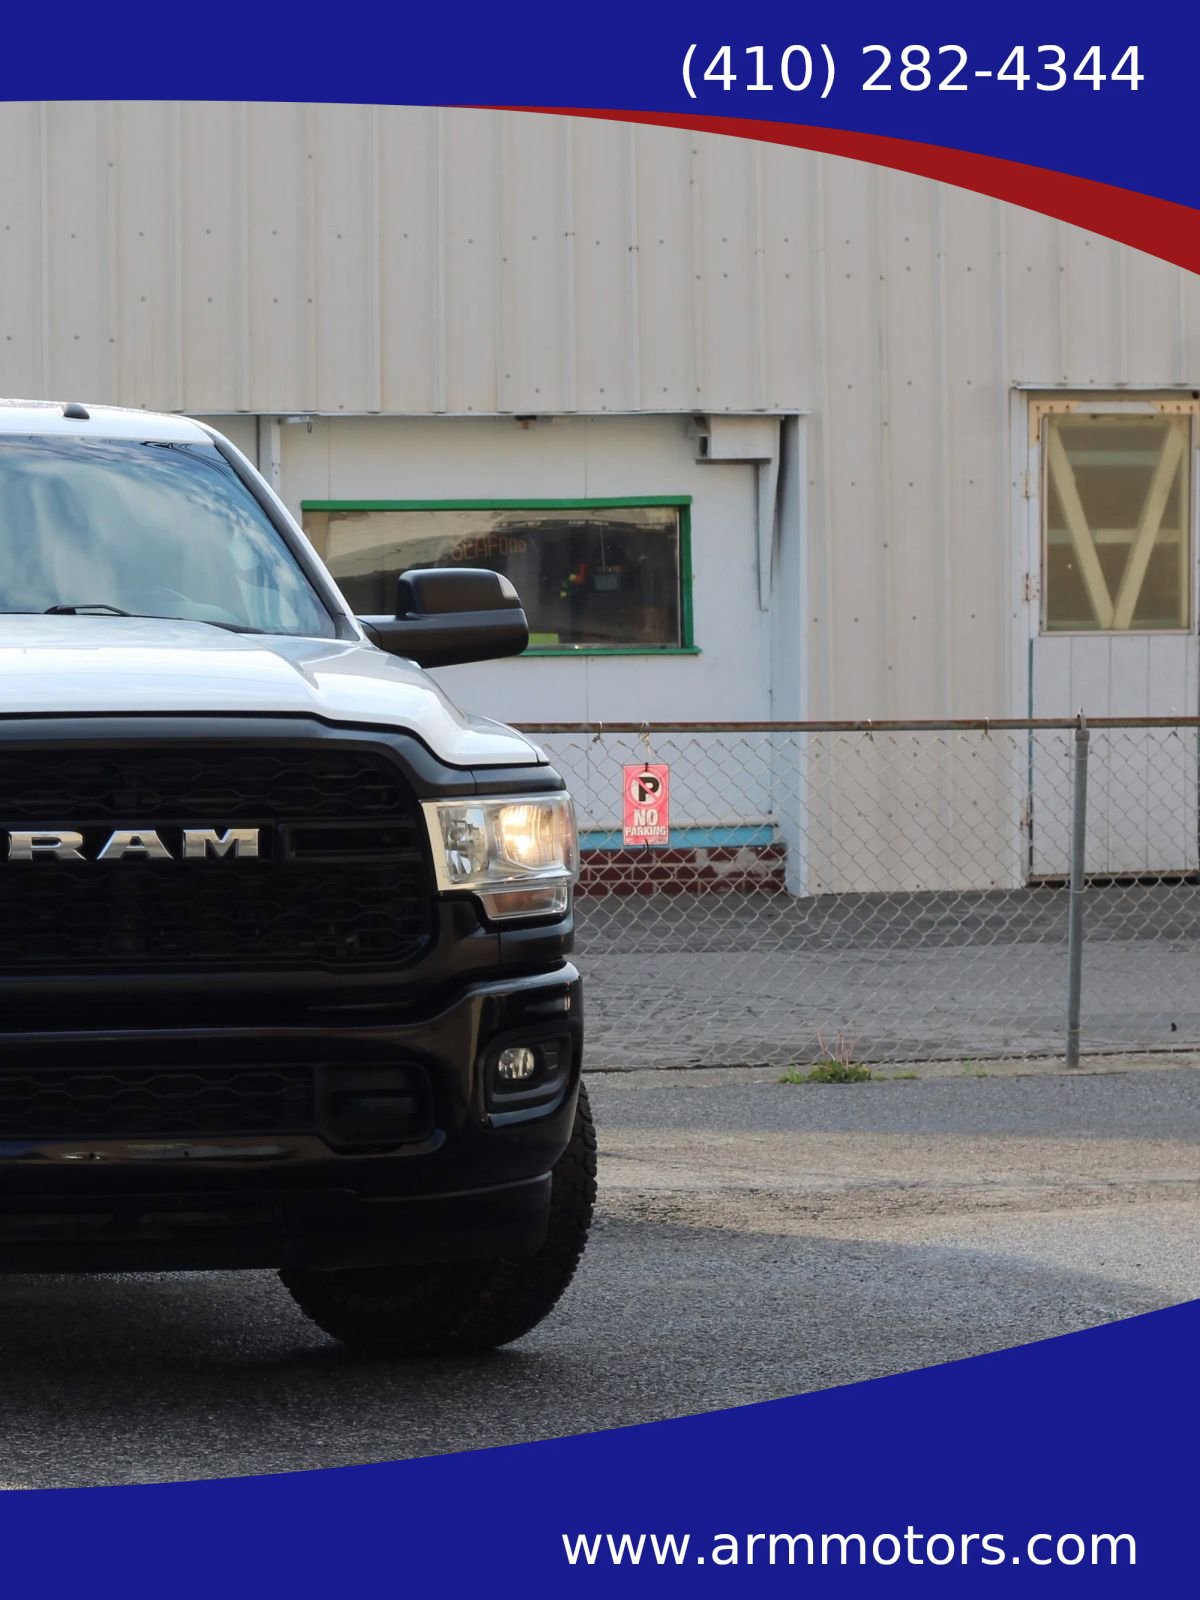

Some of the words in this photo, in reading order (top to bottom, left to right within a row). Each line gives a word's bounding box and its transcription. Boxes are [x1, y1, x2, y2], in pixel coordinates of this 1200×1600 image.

[633, 808, 658, 826] NO
[625, 827, 666, 836] PARKING
[8, 828, 260, 861] RAM
